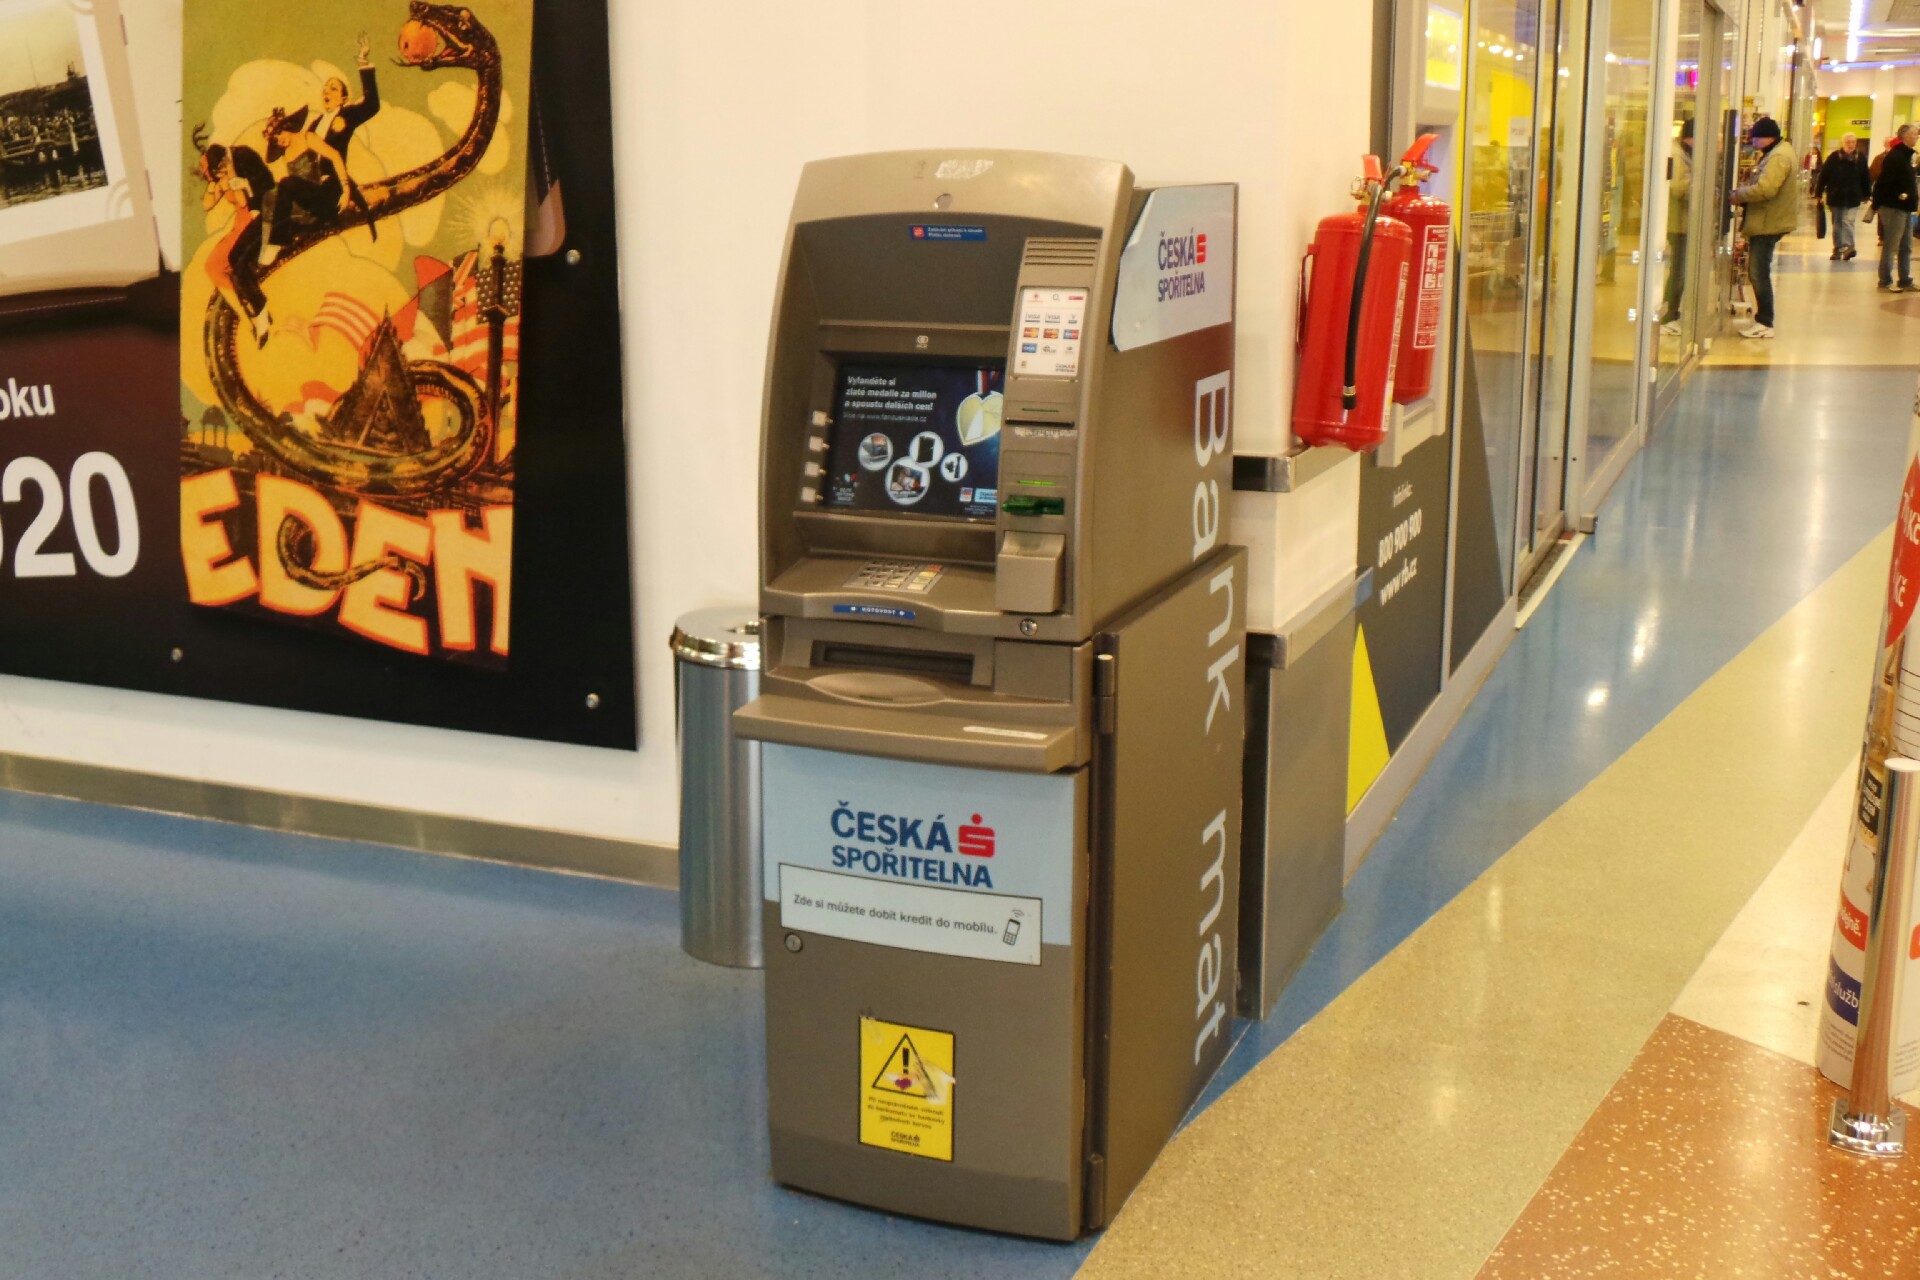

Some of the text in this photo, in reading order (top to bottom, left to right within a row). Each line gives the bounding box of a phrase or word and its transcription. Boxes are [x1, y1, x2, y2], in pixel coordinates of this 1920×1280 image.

[1158, 227, 1195, 270] ČESKÁ
[1158, 270, 1205, 302] SPOŘITELNA
[0, 451, 140, 578] 20
[831, 800, 953, 853] ČESKÁ
[832, 845, 993, 889] SPOŘITELNA
[794, 894, 813, 907] Zde
[815, 899, 824, 909] si
[827, 901, 866, 916] můžete
[900, 911, 932, 926] kredit
[936, 916, 951, 929] do
[954, 920, 998, 935] mobilu.
[1833, 981, 1860, 1013] služb
